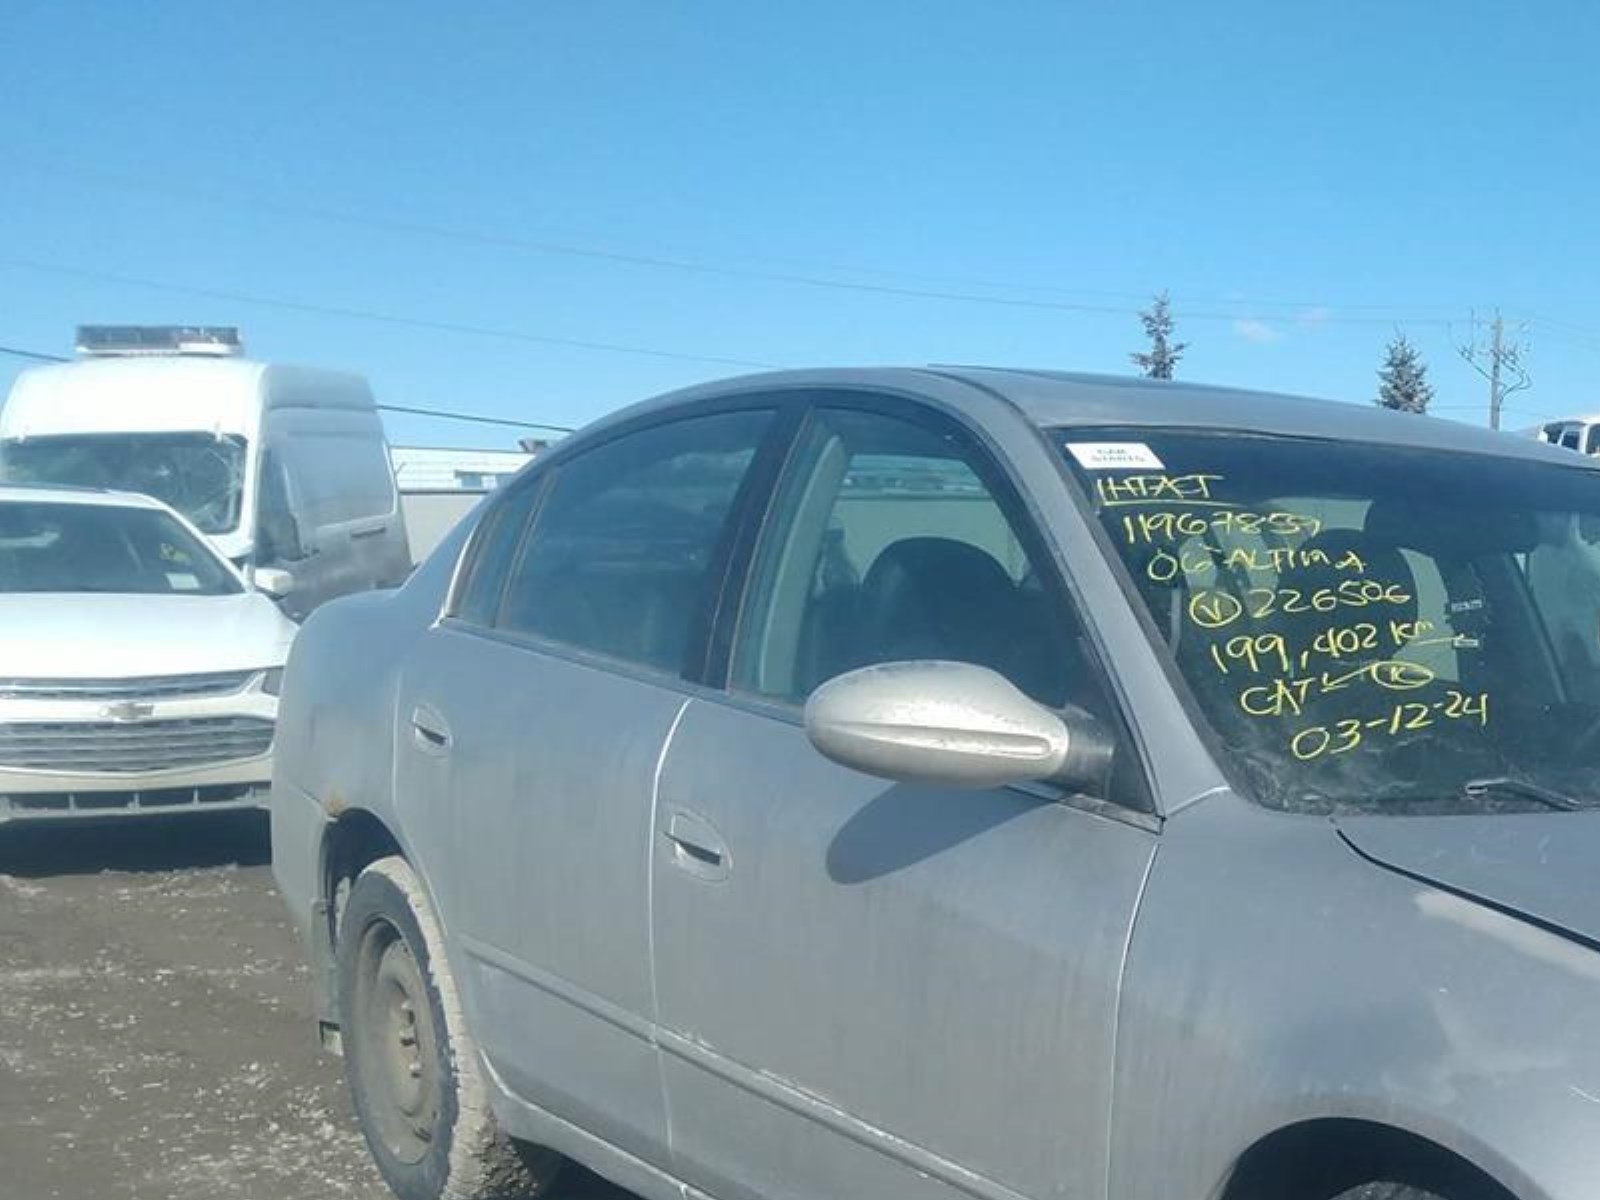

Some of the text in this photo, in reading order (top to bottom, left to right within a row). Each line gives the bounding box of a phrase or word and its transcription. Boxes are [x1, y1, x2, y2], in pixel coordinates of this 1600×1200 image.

[1122, 510, 1321, 544] 11967859
[1246, 578, 1412, 619] 226506
[1291, 690, 1489, 760] 03-12-24
